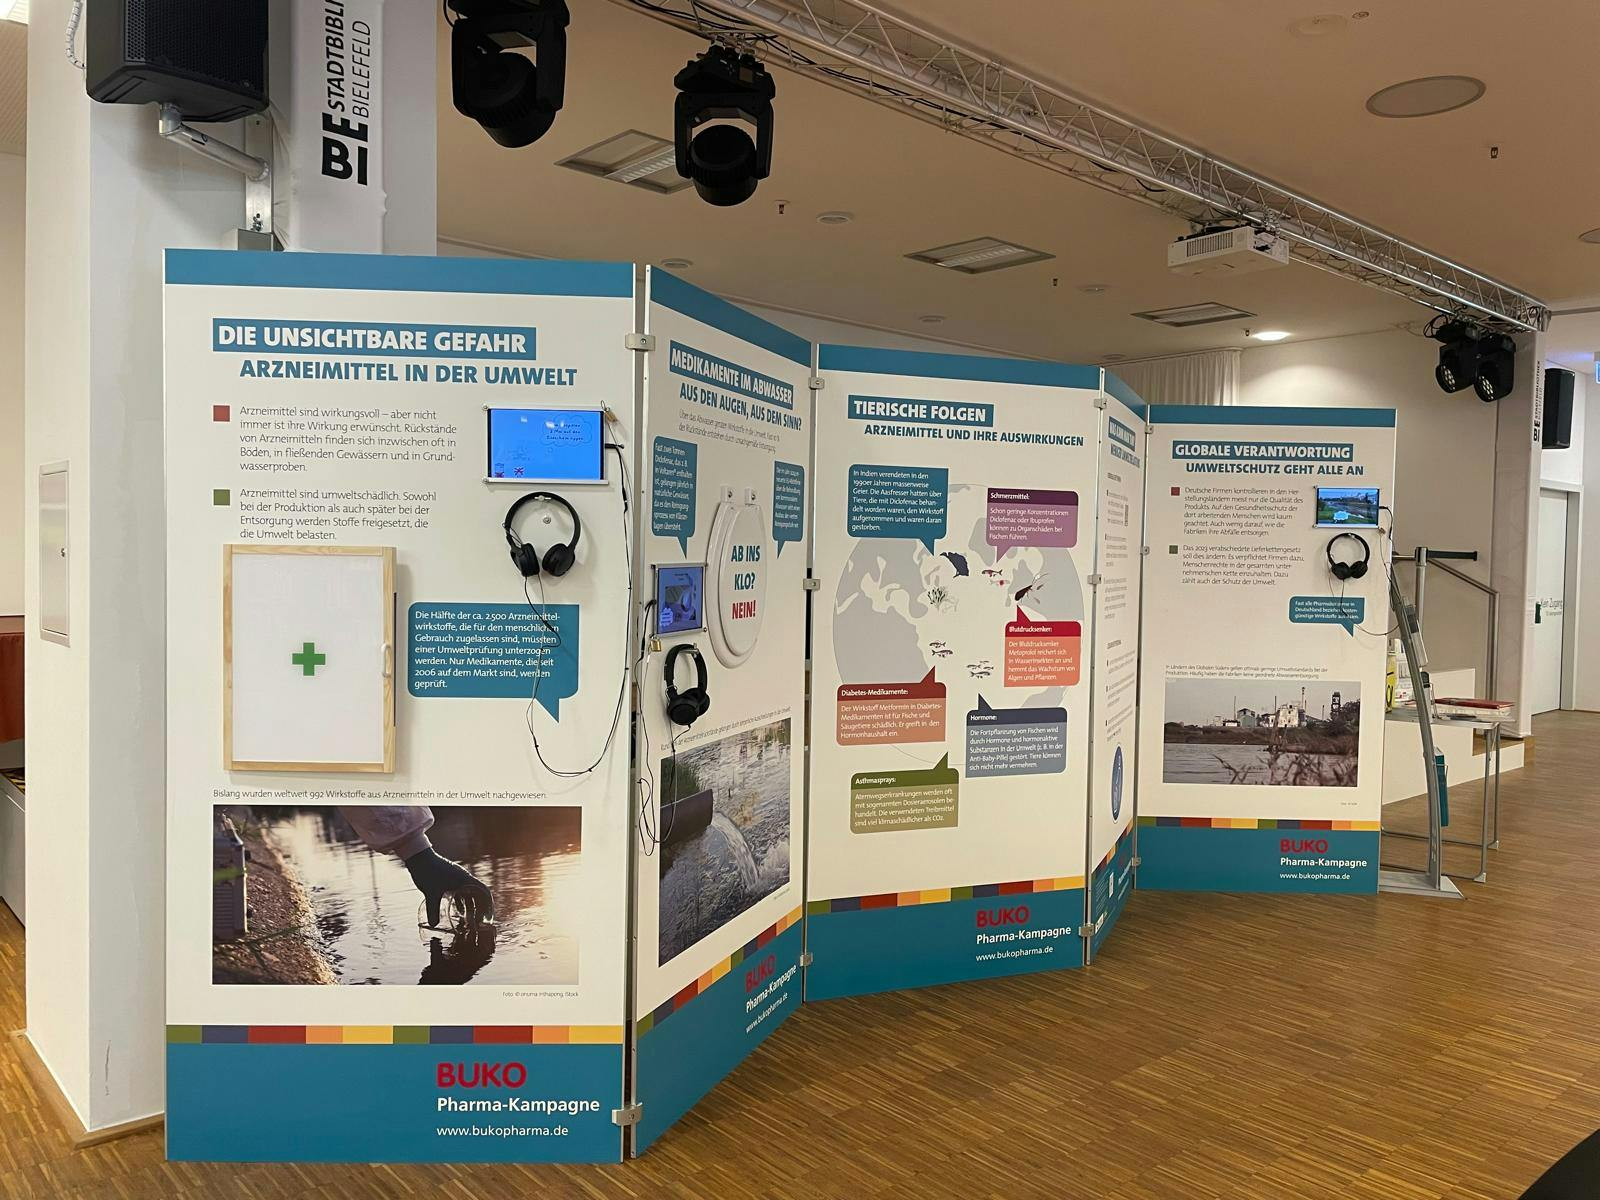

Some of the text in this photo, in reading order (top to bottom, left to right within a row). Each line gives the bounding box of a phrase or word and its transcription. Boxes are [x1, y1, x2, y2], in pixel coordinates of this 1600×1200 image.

[352, 20, 371, 118] BIELEFELD
[218, 325, 525, 352] DIE UNSICHTBARE GEFAHR
[240, 360, 577, 385] ARZNEIMITTEL IN DER UMWELT
[672, 348, 792, 405] MEDIKAMENTE IM ABWASSER
[680, 383, 802, 431] AUS DEN AUGEN, AUS DEM SINN?
[855, 401, 985, 421] TIERISCHE FOLGEN
[864, 424, 1083, 445] ARZNEIMITTEL UND IHRE AUSWIRKUNGEN
[1175, 444, 1350, 457] GLOBALE VERANTWORTUNG
[1185, 462, 1363, 475] UMWELTSCHUTZ GEHT ALLE AN
[239, 489, 297, 498] Arzneimittel
[299, 489, 318, 498] sind
[402, 491, 436, 500] Sowohl
[240, 501, 429, 515] bei der Produktion als auch später bei der
[240, 515, 428, 529] Entsorgung werden Stoffe freigesetzt, die
[239, 528, 337, 539] die Umwelt belasten.
[731, 545, 760, 562] AB INS
[734, 572, 755, 590] KLO?
[430, 610, 455, 619] Hälfte
[456, 611, 470, 619] der
[732, 600, 756, 620] NEIN!
[473, 622, 485, 630] für
[487, 623, 503, 631] den
[455, 634, 499, 644] zugelassen
[501, 634, 520, 643] sind,
[522, 635, 556, 645] müssten
[437, 645, 503, 655] Umweltprüfung
[525, 657, 539, 667] die
[499, 668, 518, 677] sind,
[519, 669, 550, 678] werden
[414, 679, 448, 689] geprüft.
[855, 776, 896, 785] Asthmasprays:
[213, 789, 240, 799] Bislang
[309, 791, 324, 799] 992
[325, 789, 365, 797] Wirkstoffe
[1280, 839, 1329, 854] BUKO
[1280, 857, 1368, 869] Pharma-Kampagne
[1280, 873, 1351, 881] www.bukopharma.de
[976, 906, 1030, 928] BUKO
[976, 926, 1072, 944] Pharma-Kampagne
[976, 946, 1053, 962] www.bukopharma.de
[745, 955, 776, 992] BUKO
[746, 965, 797, 1013] Pharma-Kampagne
[746, 992, 788, 1034] www.bukopharma.de
[436, 1062, 528, 1089] BUKO
[437, 1096, 600, 1116] Pharma-Kampagne
[437, 1125, 569, 1138] www.bukopharma.de
